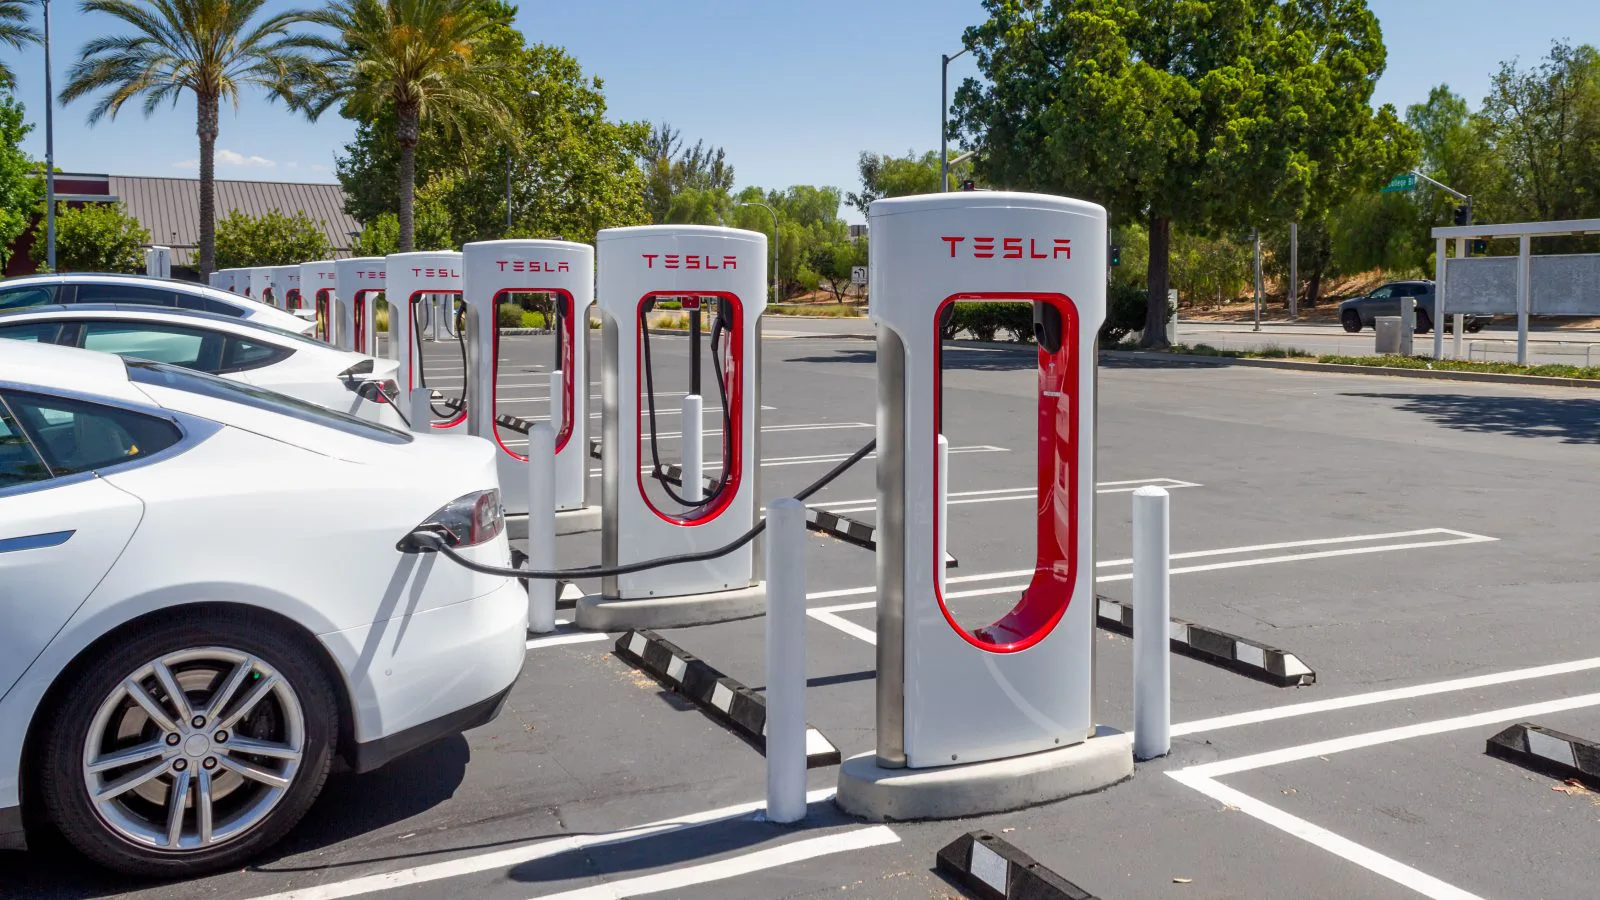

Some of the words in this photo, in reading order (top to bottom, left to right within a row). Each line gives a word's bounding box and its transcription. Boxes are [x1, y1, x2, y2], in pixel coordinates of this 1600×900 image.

[941, 236, 1071, 260] TESLA
[496, 261, 568, 272] TESLA
[640, 254, 737, 270] TESLA
[356, 271, 386, 279] TES
[411, 268, 464, 278] TESL
